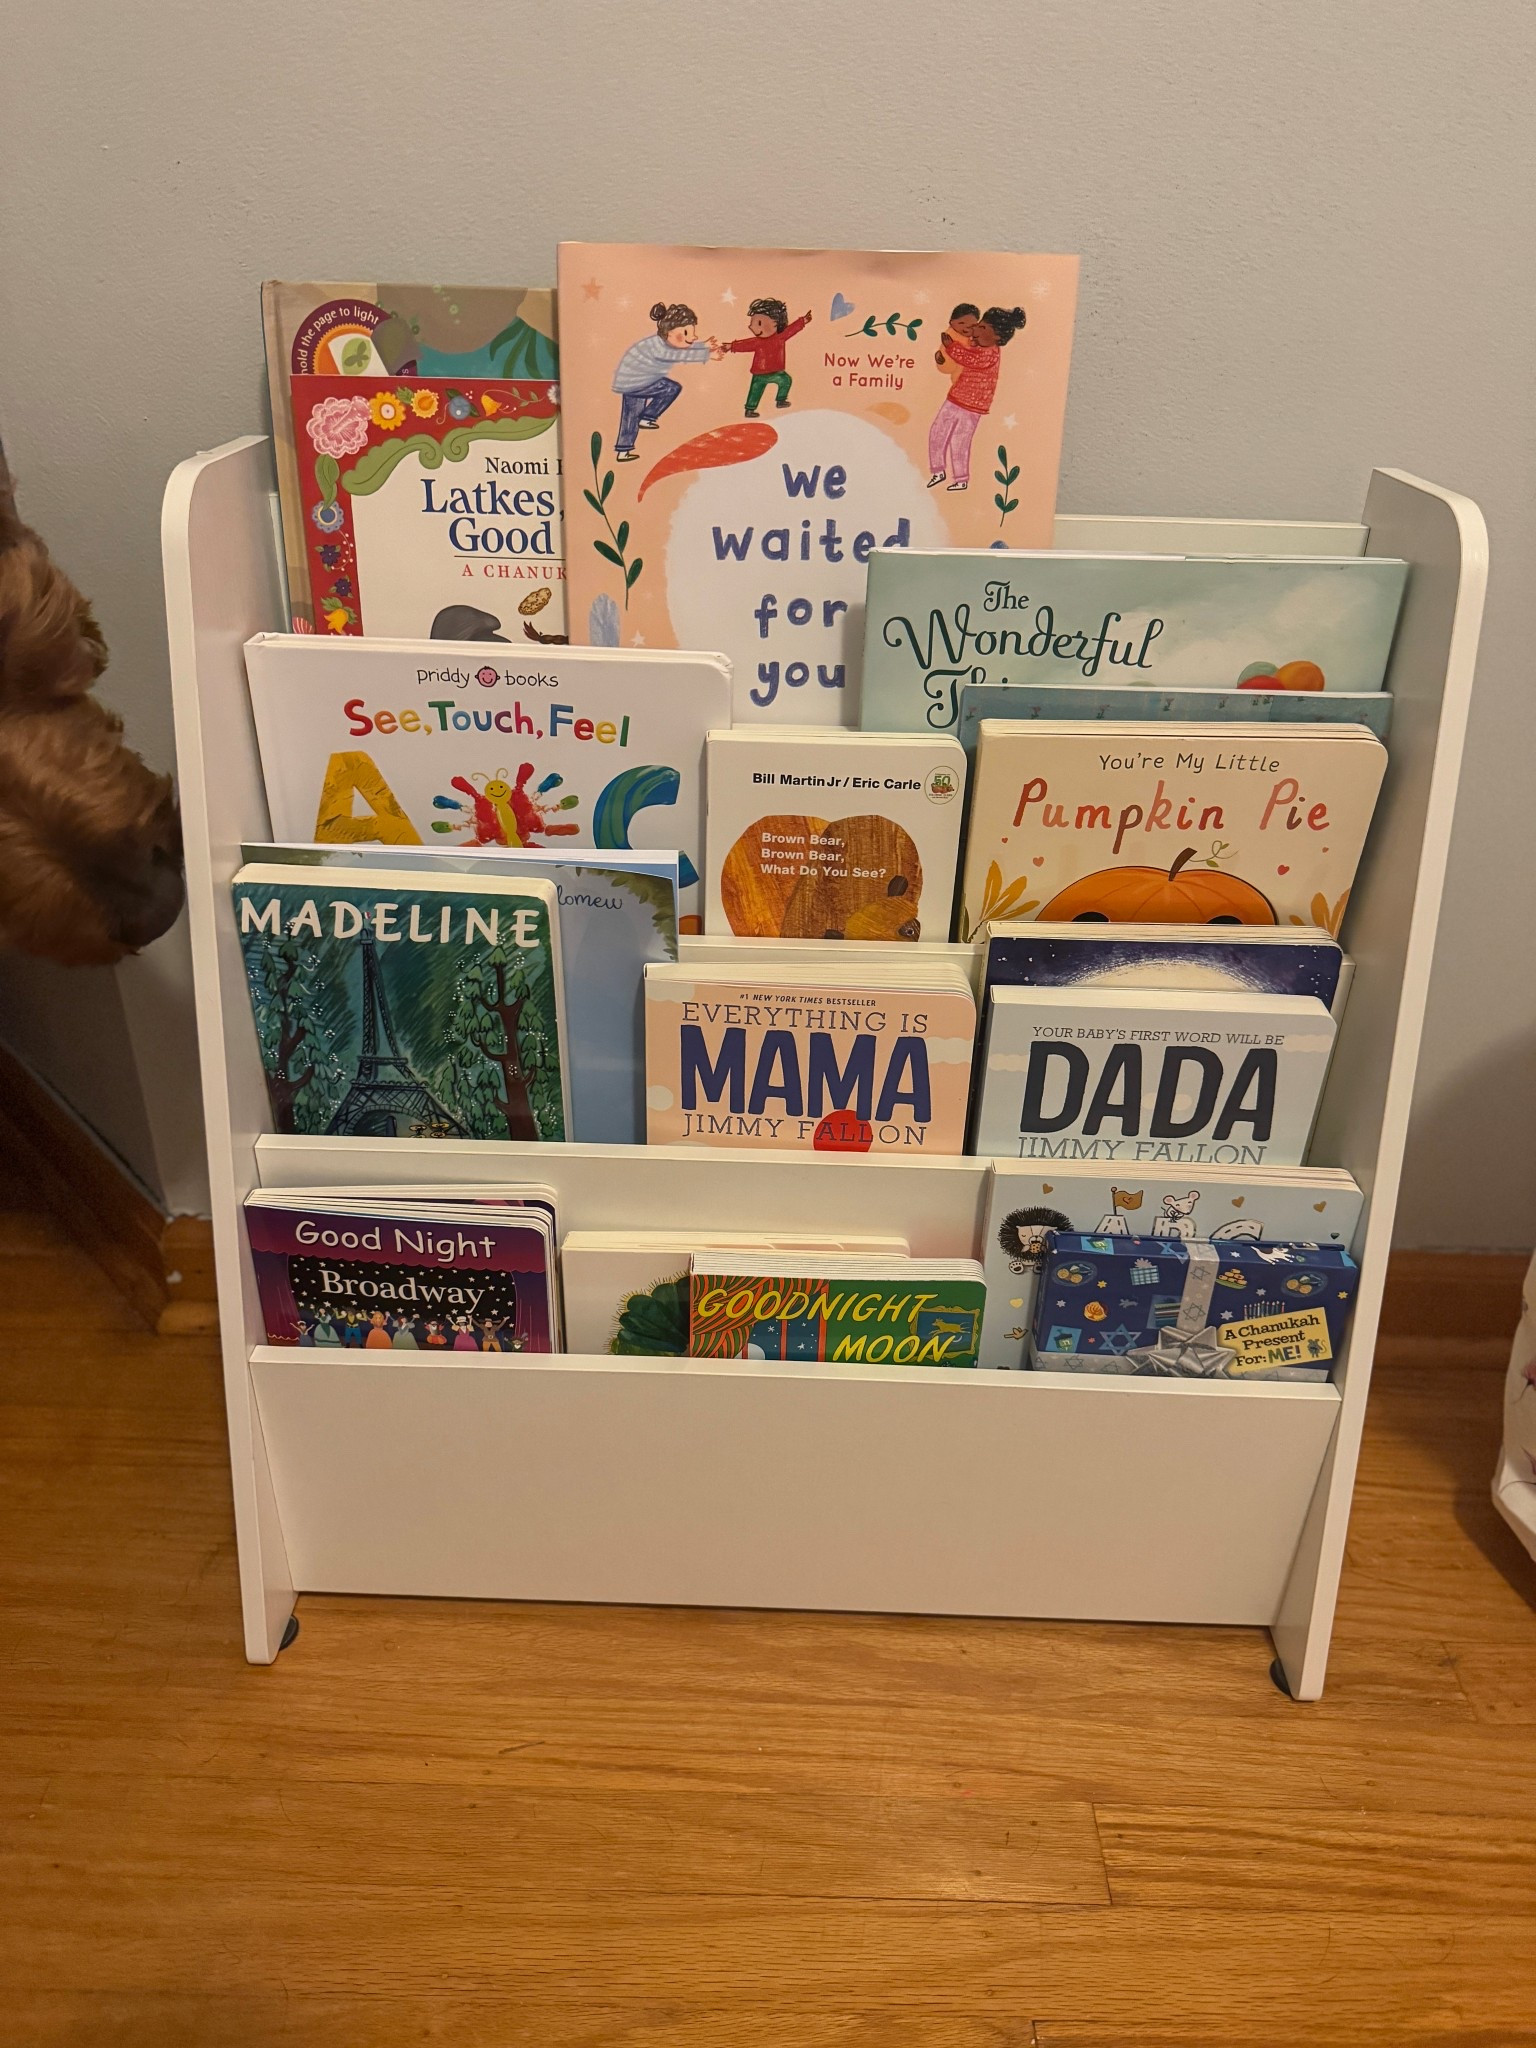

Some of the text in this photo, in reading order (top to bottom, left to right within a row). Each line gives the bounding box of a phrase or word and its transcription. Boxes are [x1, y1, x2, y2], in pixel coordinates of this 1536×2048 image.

[301, 328, 316, 347] the
[313, 310, 337, 331] page
[339, 307, 350, 317] to
[354, 305, 379, 325] light
[824, 352, 915, 368] Now We're
[832, 373, 903, 390] a Family
[485, 456, 550, 475] Naomi
[782, 463, 847, 500] we
[449, 517, 555, 554] Good
[462, 564, 474, 577] A
[983, 580, 1030, 612] The
[754, 593, 848, 639] for
[883, 603, 1164, 677] Wonderful
[416, 667, 559, 689] priddy books
[750, 661, 846, 707] you
[549, 703, 631, 748] Feel
[1099, 752, 1280, 774] You're My Little
[752, 772, 775, 785] Bill
[780, 774, 825, 787] Martin
[826, 776, 841, 787] Jr
[852, 777, 880, 789] Eric
[883, 778, 922, 791] Carle
[1012, 777, 1330, 855] Pumpkin Pie
[761, 832, 845, 847] Brown Bear,
[761, 849, 845, 863] Brown Bear,
[760, 864, 887, 879] What Do You See?
[239, 896, 541, 948] MADELINE
[775, 995, 797, 1003] YORK
[799, 996, 823, 1004] TIMES
[826, 998, 876, 1007] BESTSELLER
[682, 1001, 928, 1034] EVERYTHING IS
[1032, 1026, 1285, 1046] YOUR BABY'S FIRST WORD WILL BE
[680, 1024, 932, 1123] MAMA
[1020, 1040, 1278, 1142] DADA
[682, 1113, 927, 1146] JIMMY FALLON
[1018, 1136, 1267, 1165] JIMMY FALLON
[295, 1220, 496, 1263] Good Night
[318, 1269, 486, 1314] Broadway
[697, 1288, 939, 1323] GOODNIGHT
[1224, 1314, 1320, 1340] A Chanukah
[1242, 1330, 1306, 1350] Present
[832, 1334, 957, 1363] MOON
[1235, 1345, 1301, 1366] For: ME!
